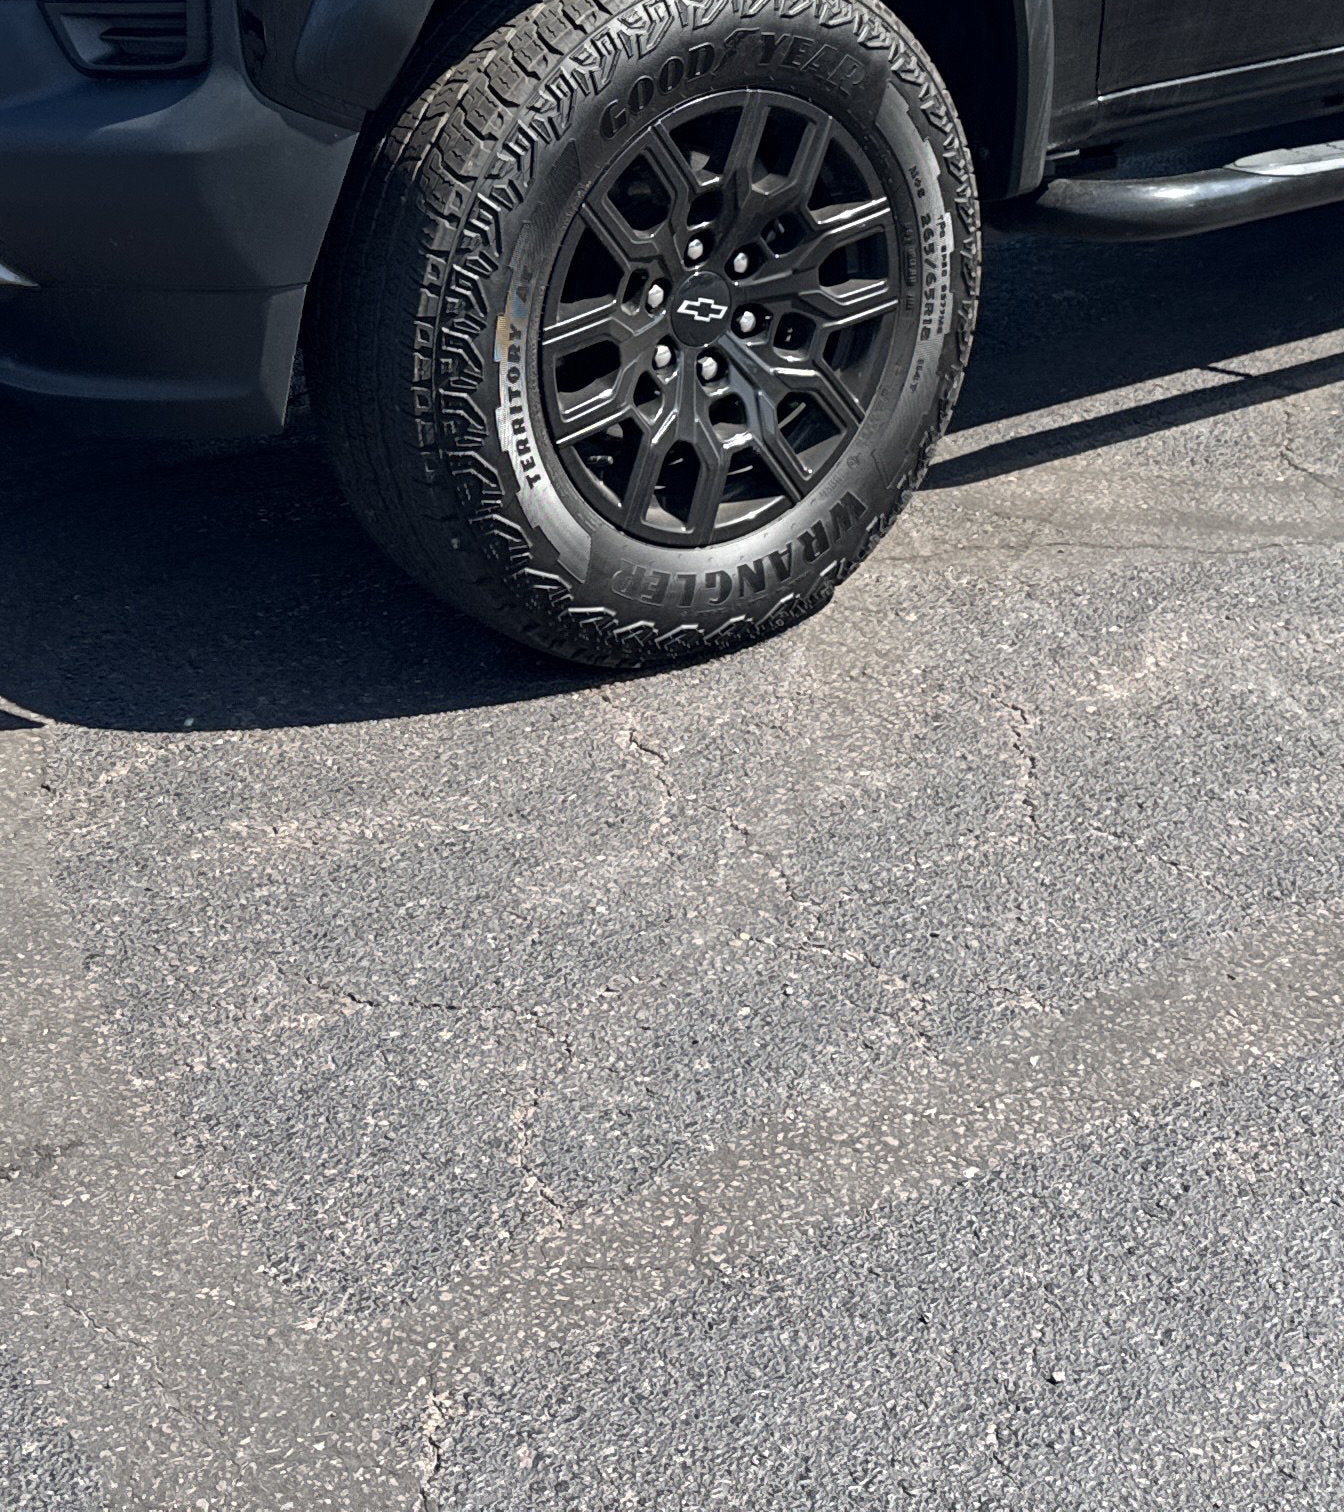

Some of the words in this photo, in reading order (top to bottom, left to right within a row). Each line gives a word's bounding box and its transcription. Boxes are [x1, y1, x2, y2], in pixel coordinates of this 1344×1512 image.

[920, 213, 937, 342] 265/65R18
[508, 324, 541, 489] TERRITORY
[610, 491, 869, 608] WRANGLER
